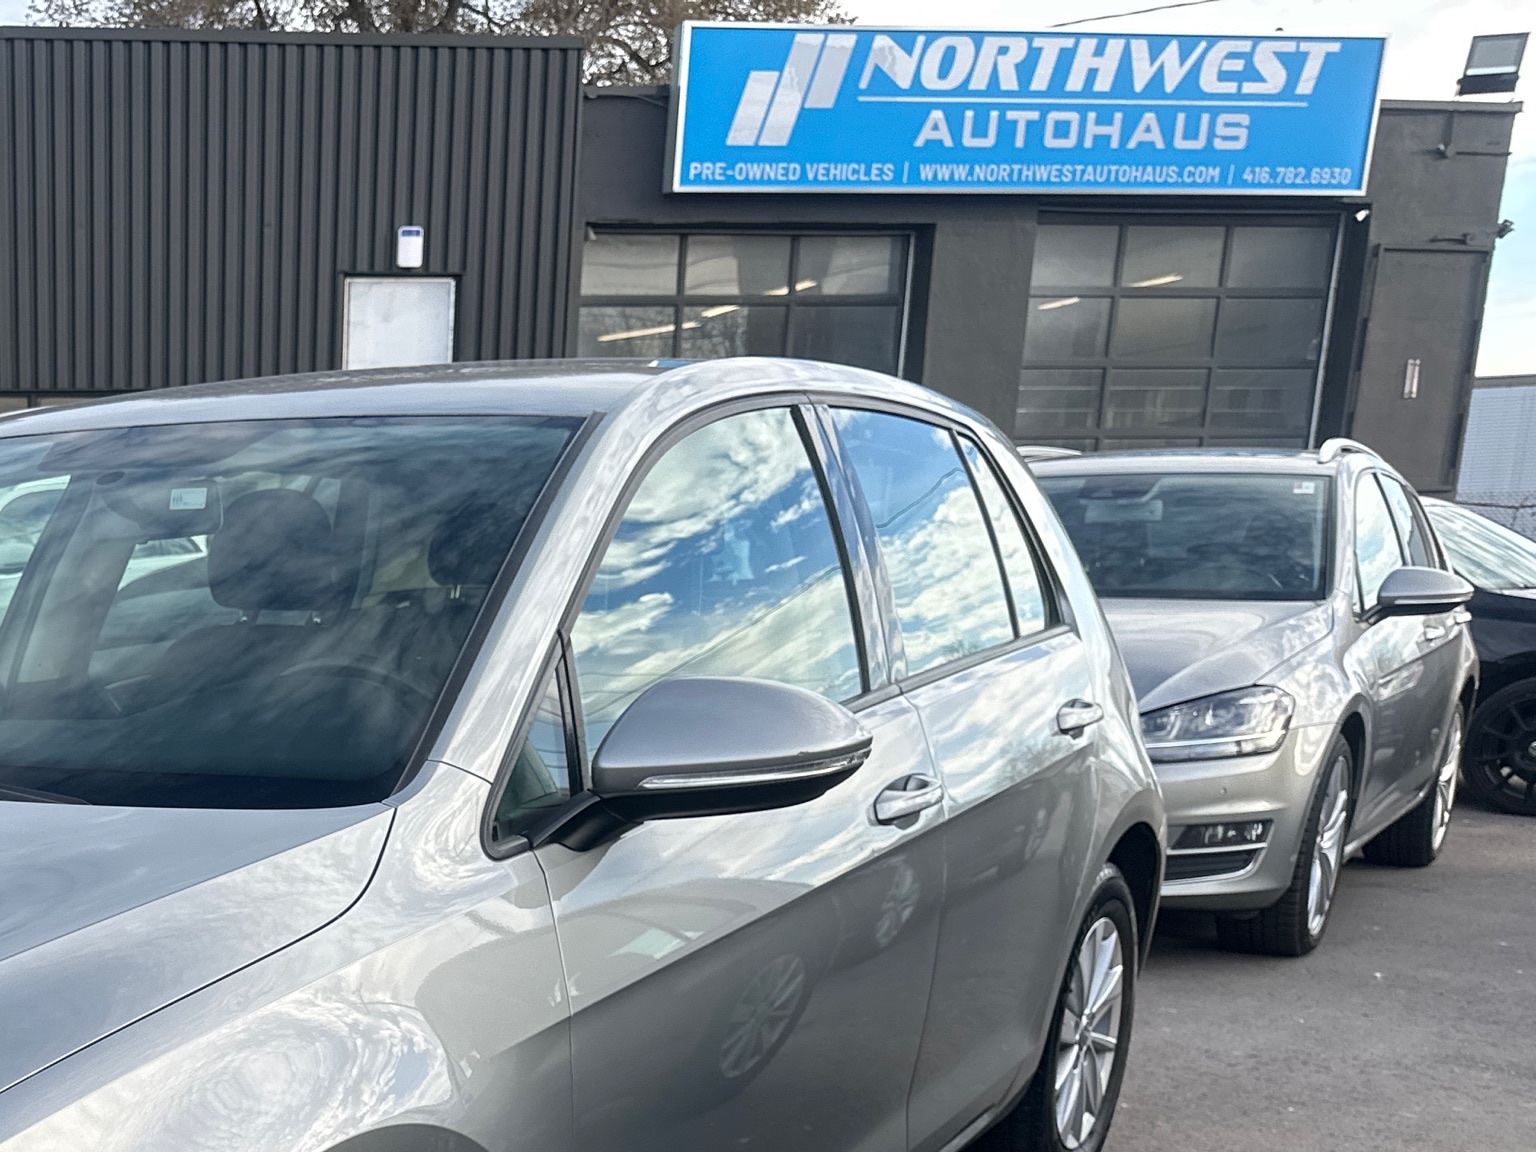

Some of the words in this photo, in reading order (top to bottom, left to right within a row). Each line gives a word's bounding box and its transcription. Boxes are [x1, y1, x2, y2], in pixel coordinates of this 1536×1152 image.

[858, 34, 1342, 96] NORTHWEST
[913, 109, 1251, 151] AUTOHAUS
[689, 161, 801, 182] PRE-OWNED
[805, 162, 895, 183] VEHICLES
[919, 162, 1220, 184] WWW.NORTHWESTAUTOHAUS.COM
[1242, 166, 1352, 186] 416.782.6930
